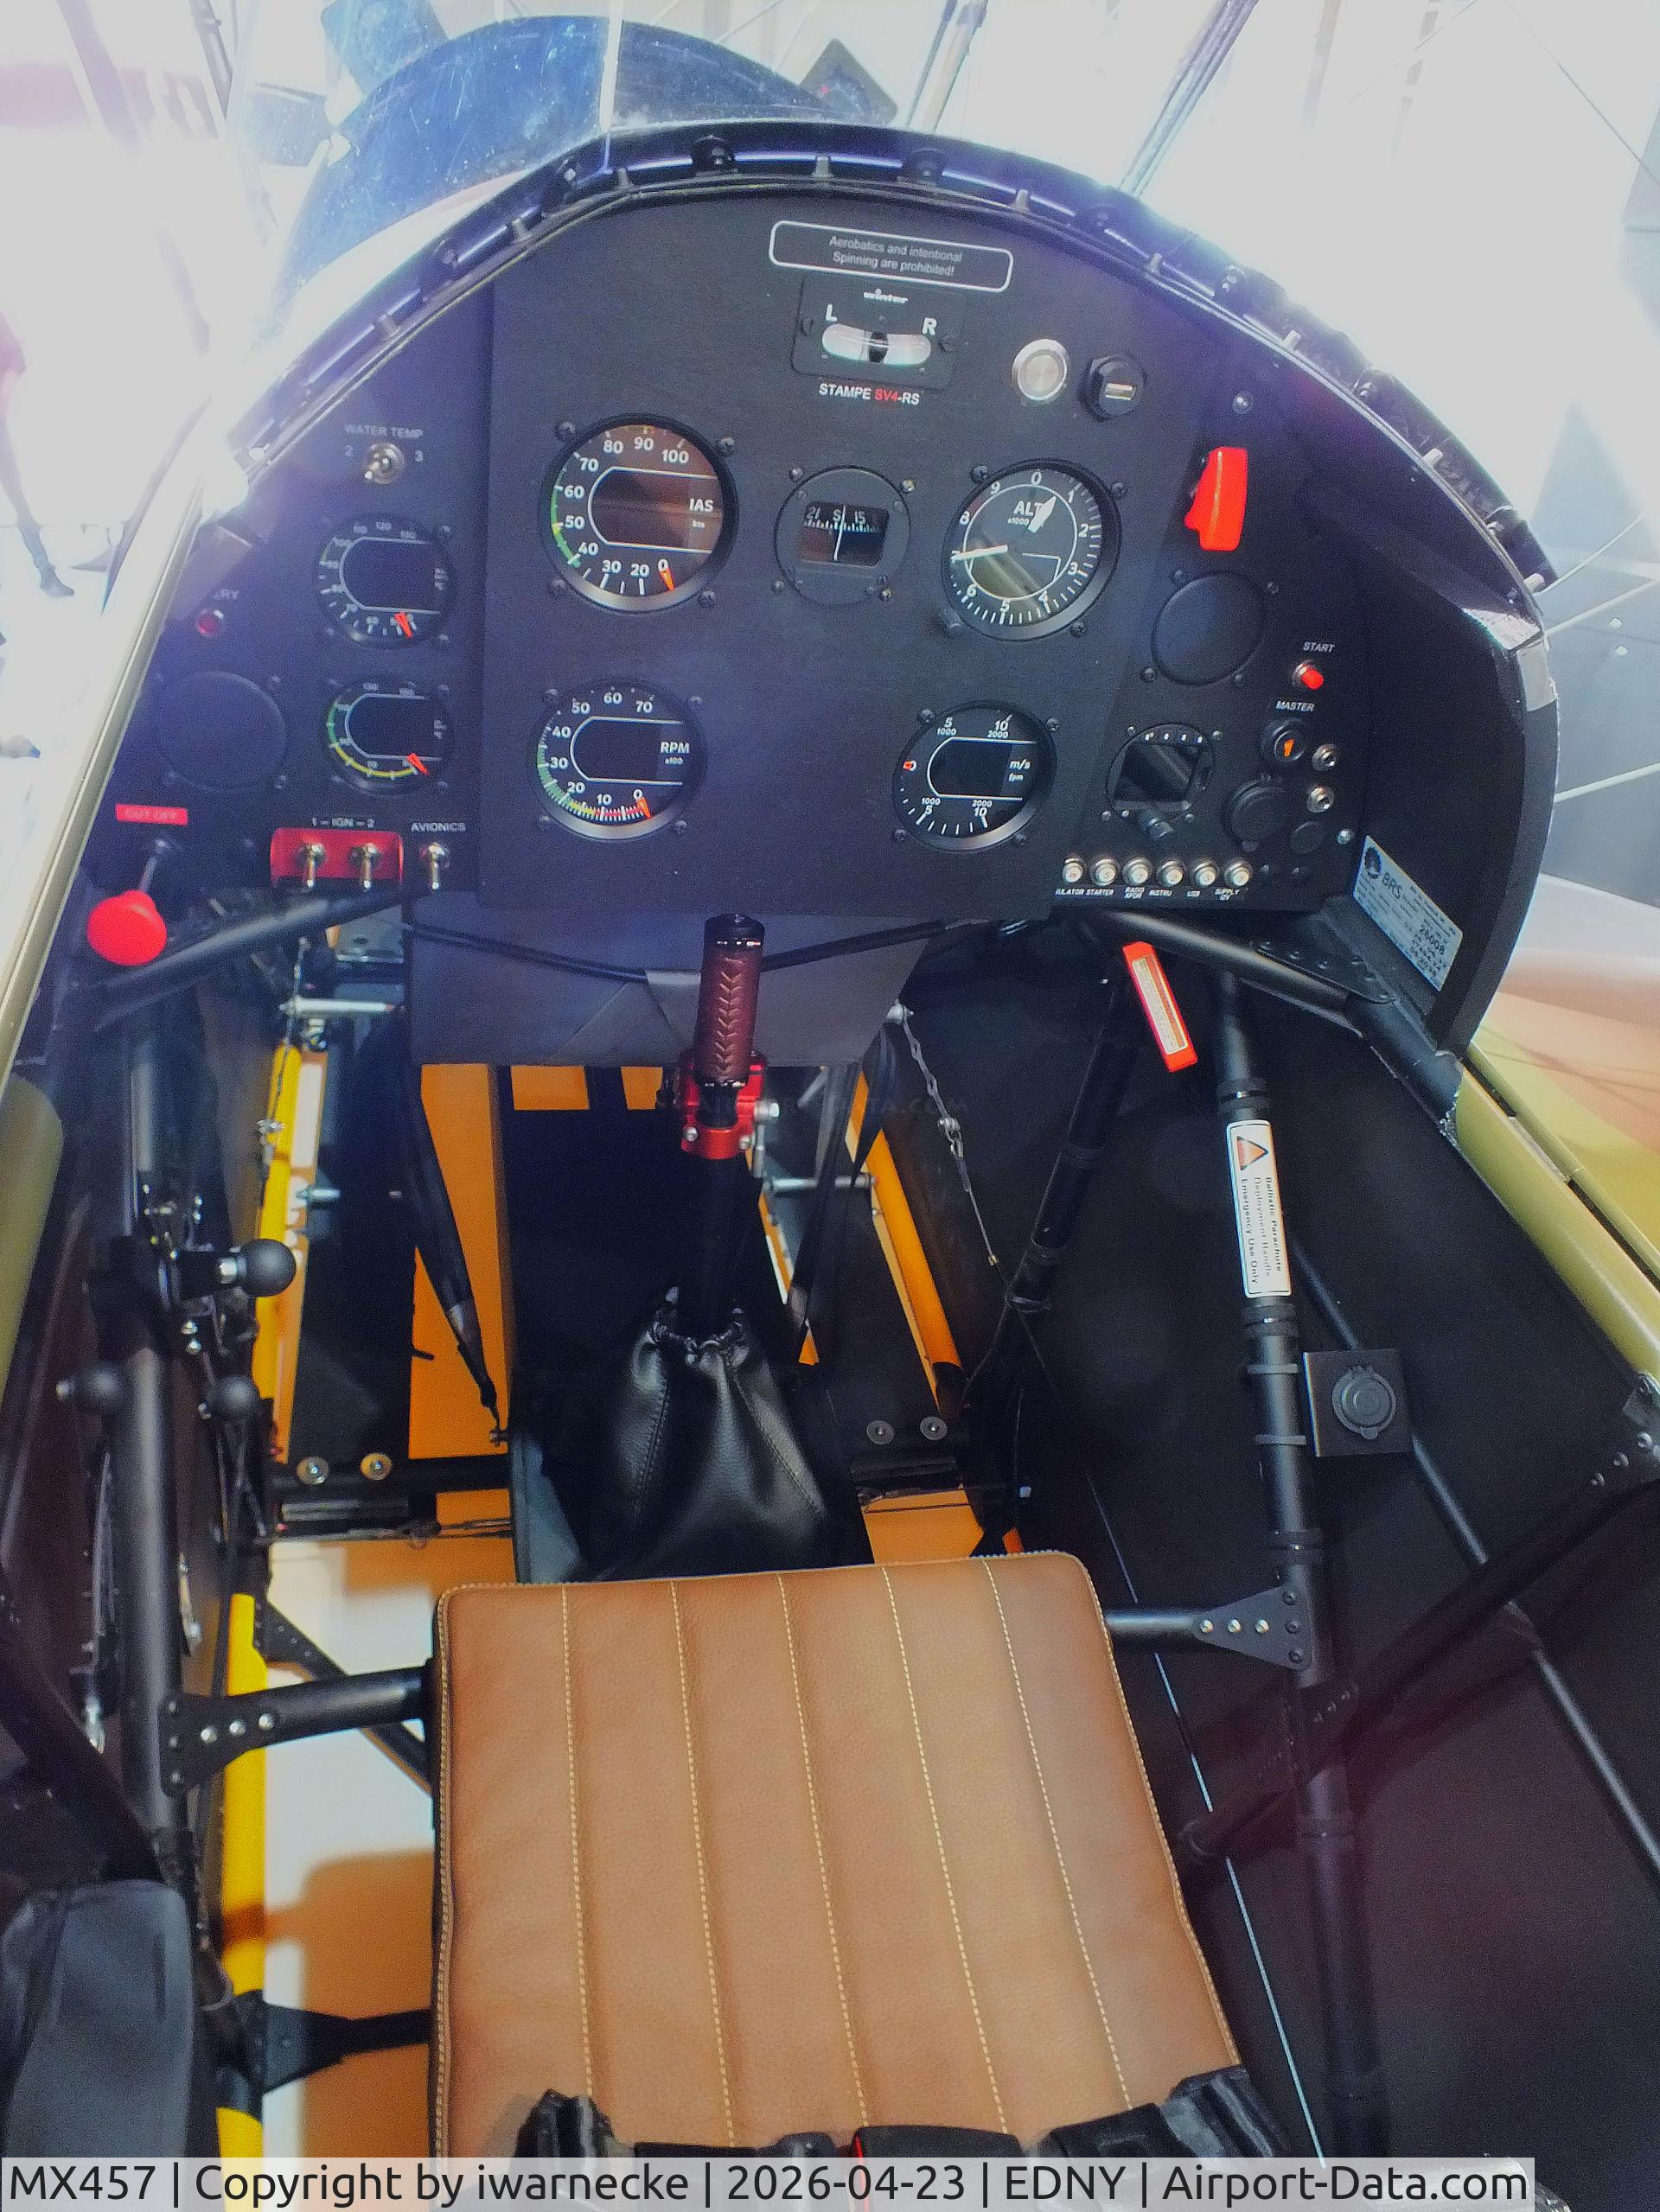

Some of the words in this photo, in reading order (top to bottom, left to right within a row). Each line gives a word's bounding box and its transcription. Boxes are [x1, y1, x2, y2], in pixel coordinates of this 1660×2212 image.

[829, 235, 884, 252] Aerobatics
[887, 245, 908, 256] and
[910, 246, 963, 263] intentional
[833, 251, 878, 269] Spinning
[880, 258, 898, 270] are
[900, 261, 955, 277] prohibited!
[825, 304, 838, 322] L
[922, 317, 937, 335] R
[818, 383, 872, 400] STAMPE
[873, 388, 921, 405] SV4-RS
[603, 439, 624, 455] 80
[634, 436, 654, 451] 90
[661, 449, 689, 464] 100
[579, 458, 599, 472] 70
[1031, 471, 1042, 486] 0
[564, 485, 584, 499] 60
[990, 481, 1001, 495] 9
[1068, 489, 1076, 503] 1
[689, 498, 714, 513] IAS
[565, 514, 585, 530] 50
[959, 510, 970, 526] 8
[1078, 524, 1089, 538] 2
[578, 541, 599, 556] 40
[602, 559, 622, 574] 30
[629, 563, 649, 577] 20
[657, 558, 669, 571] 0
[1067, 562, 1079, 576] 3
[967, 583, 977, 598] 6
[999, 599, 1011, 613] 5
[1303, 641, 1335, 653] START
[603, 692, 622, 704] 60
[571, 702, 591, 715] 50
[635, 700, 654, 713] 70
[1275, 700, 1315, 712] MASTER
[944, 717, 953, 728] 5
[993, 720, 1009, 731] 10
[552, 726, 572, 738] 40
[660, 741, 690, 755] RPM
[550, 756, 569, 769] 30
[1009, 758, 1031, 771] m/s
[567, 781, 586, 794] 20
[632, 788, 643, 800] 0
[597, 794, 613, 806] 10
[921, 797, 941, 806] 1000
[972, 800, 993, 808] 2000
[924, 806, 933, 814] 5
[974, 807, 987, 818] 10
[411, 822, 467, 832] AVIONICS
[1242, 1178, 1253, 1234] Emergency
[1253, 1176, 1266, 1238] Deployment
[1265, 1176, 1276, 1216] Ballistic
[1271, 1220, 1282, 1272] Parachute
